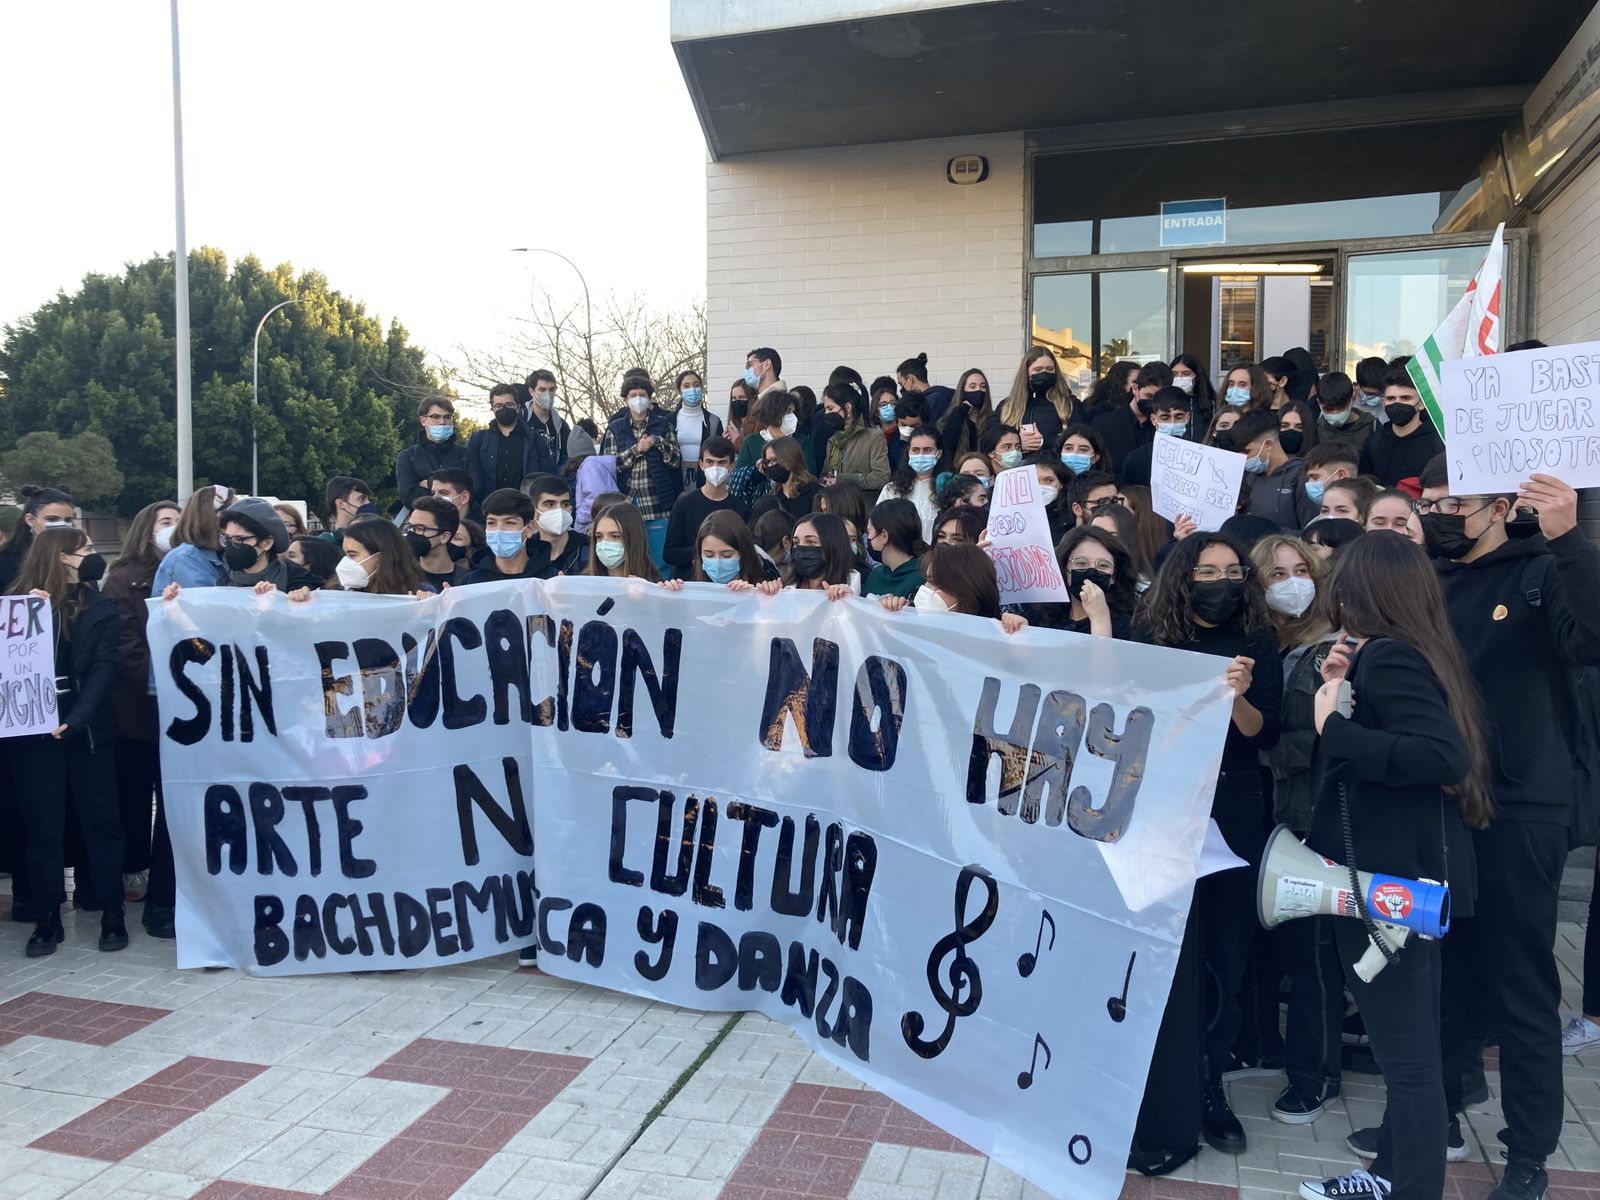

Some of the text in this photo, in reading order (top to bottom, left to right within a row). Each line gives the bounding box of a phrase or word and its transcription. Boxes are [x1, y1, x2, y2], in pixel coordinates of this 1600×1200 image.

[1164, 216, 1223, 229] ENTRADA
[1464, 366, 1500, 400] YA
[1455, 397, 1595, 434] DE JUGAR
[1001, 470, 1034, 507] NO
[1204, 488, 1233, 511] SER
[8, 641, 39, 658] POR
[13, 662, 33, 676] UN
[166, 597, 1156, 844] SIN EDUCACIÓN NO HAY
[204, 781, 378, 879] ARTE
[608, 785, 878, 951] CULTURA
[695, 920, 874, 1063] DANZA
